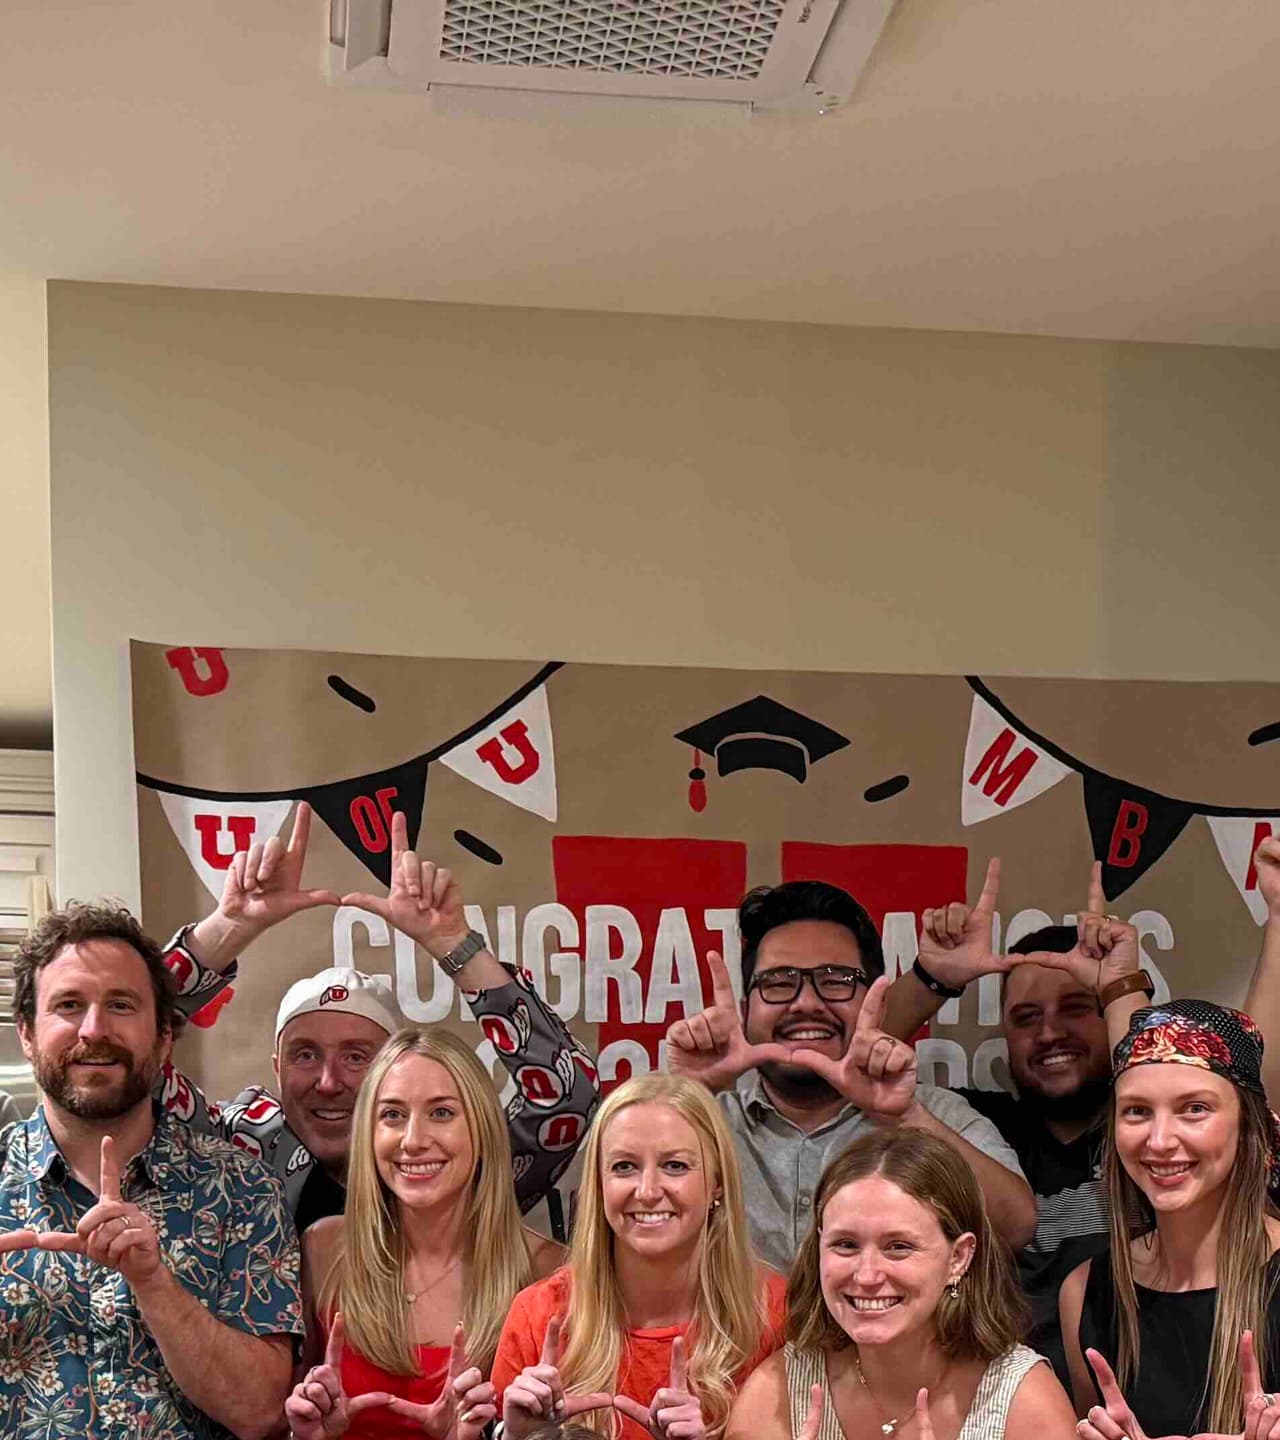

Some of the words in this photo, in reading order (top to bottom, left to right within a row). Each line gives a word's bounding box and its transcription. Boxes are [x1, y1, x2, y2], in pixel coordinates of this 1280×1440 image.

[166, 647, 229, 696] U
[195, 814, 256, 870] U
[476, 719, 540, 784] U
[968, 727, 1039, 807] M
[1107, 799, 1148, 868] B
